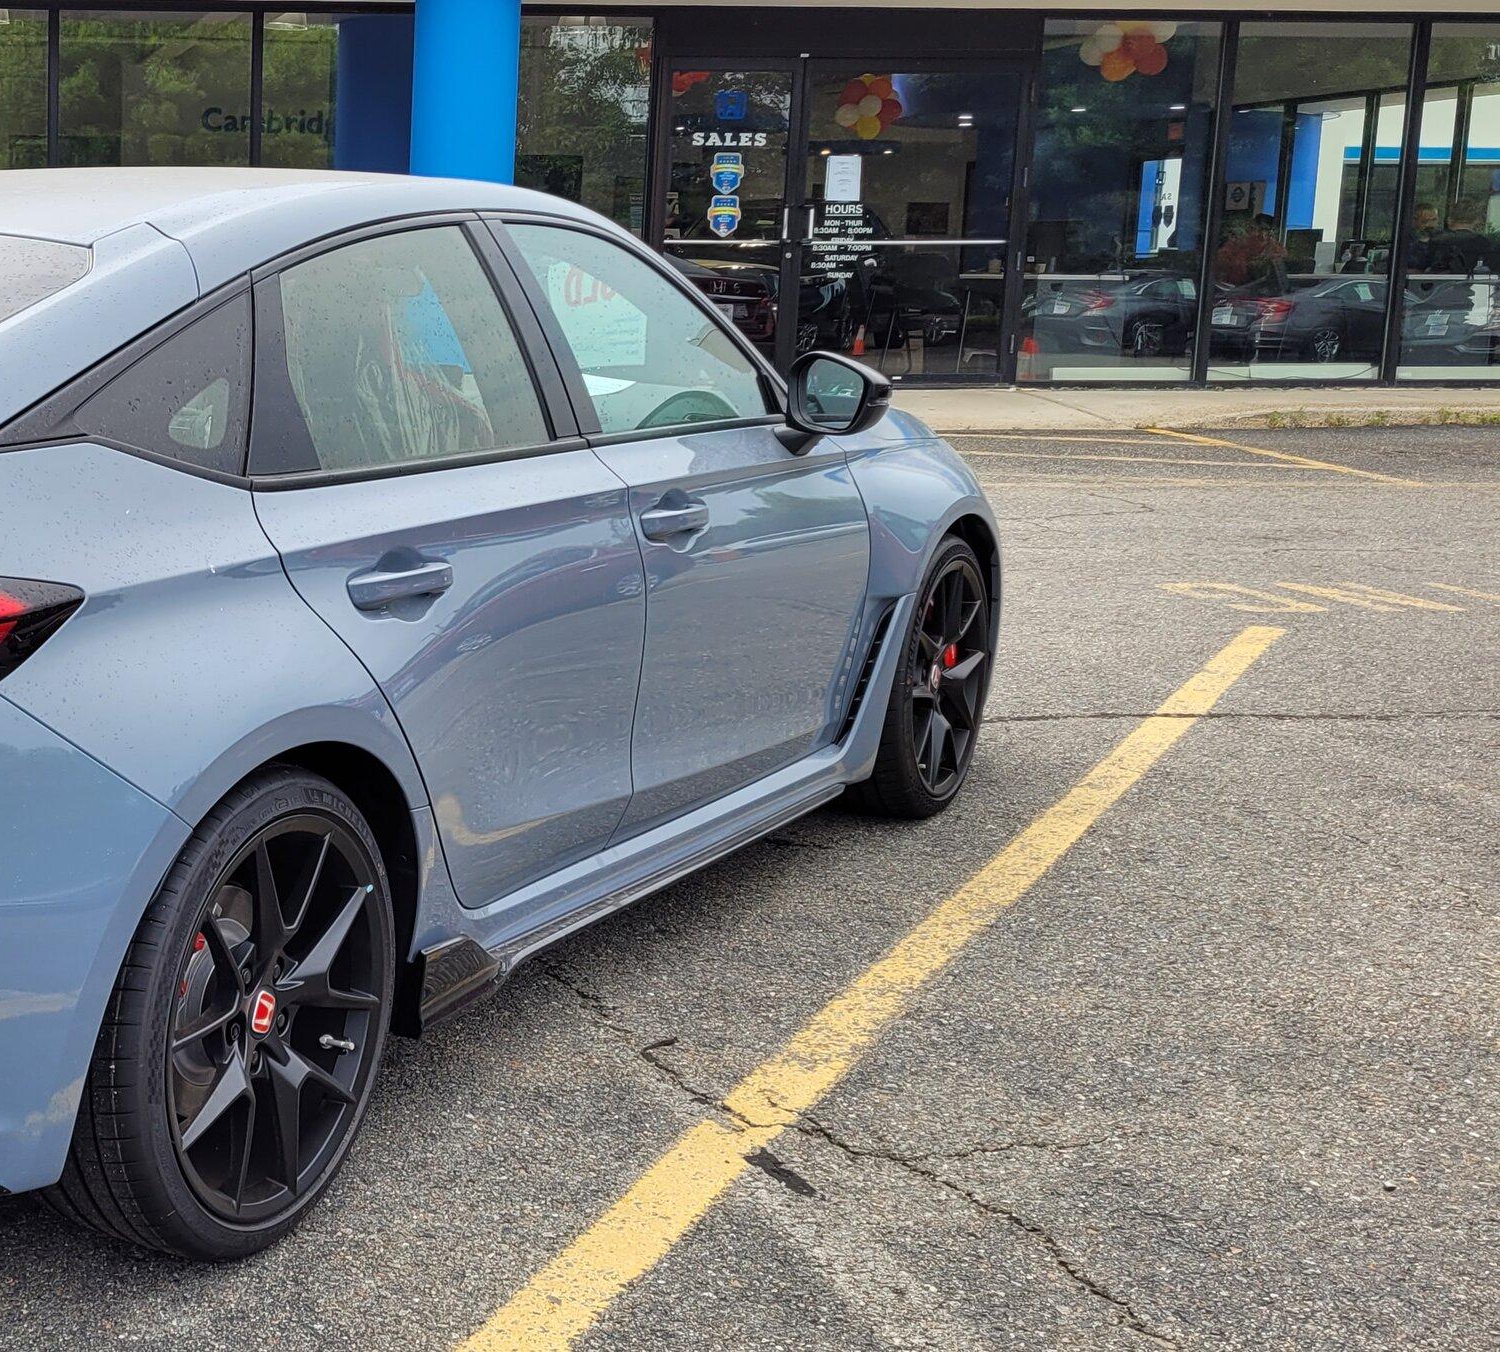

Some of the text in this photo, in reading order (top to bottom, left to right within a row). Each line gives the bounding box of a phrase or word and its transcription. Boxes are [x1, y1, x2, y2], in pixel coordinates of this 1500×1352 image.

[692, 132, 767, 147] SALES
[825, 203, 864, 215] HOURS
[810, 261, 837, 269] 8:30AM
